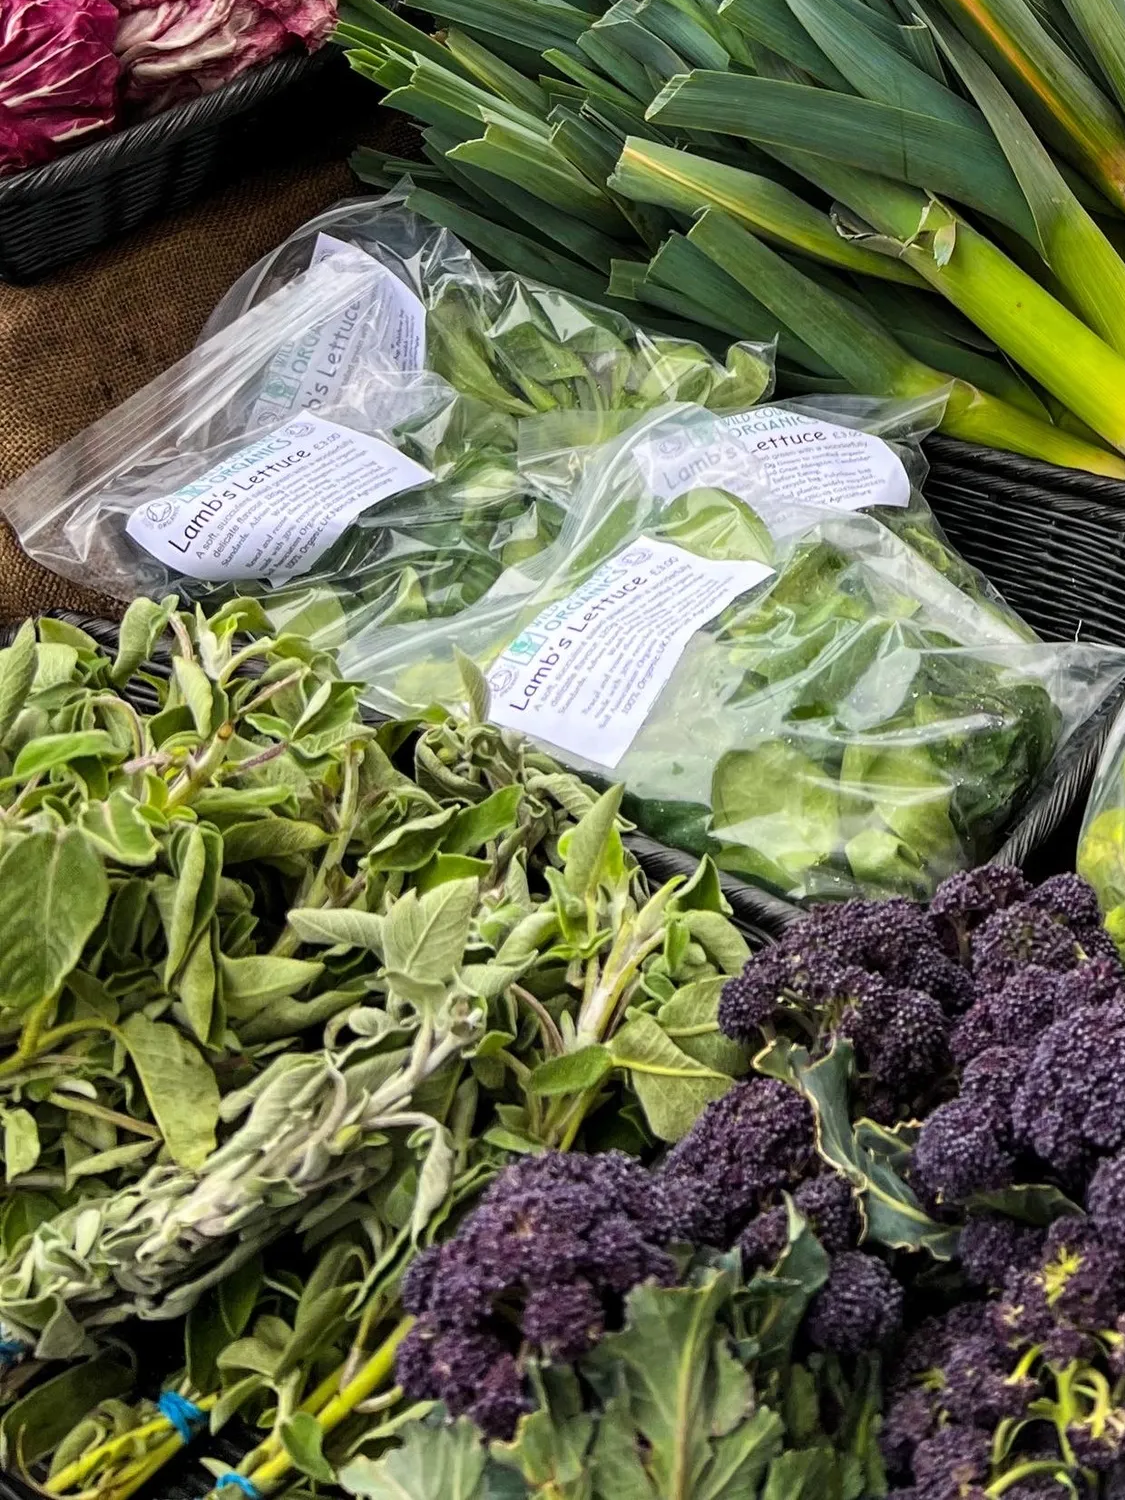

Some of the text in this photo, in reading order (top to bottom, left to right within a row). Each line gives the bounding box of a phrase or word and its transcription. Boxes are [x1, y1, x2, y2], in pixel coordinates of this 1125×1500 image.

[316, 298, 363, 376] Lettuce
[168, 431, 341, 551] Lamb's Lettuce £3.00
[211, 433, 290, 484] ORGANICS
[211, 524, 241, 559] delicate
[545, 565, 626, 632] ORGANICS
[509, 636, 572, 710] Lamb's
[569, 572, 645, 633] Lettuce
